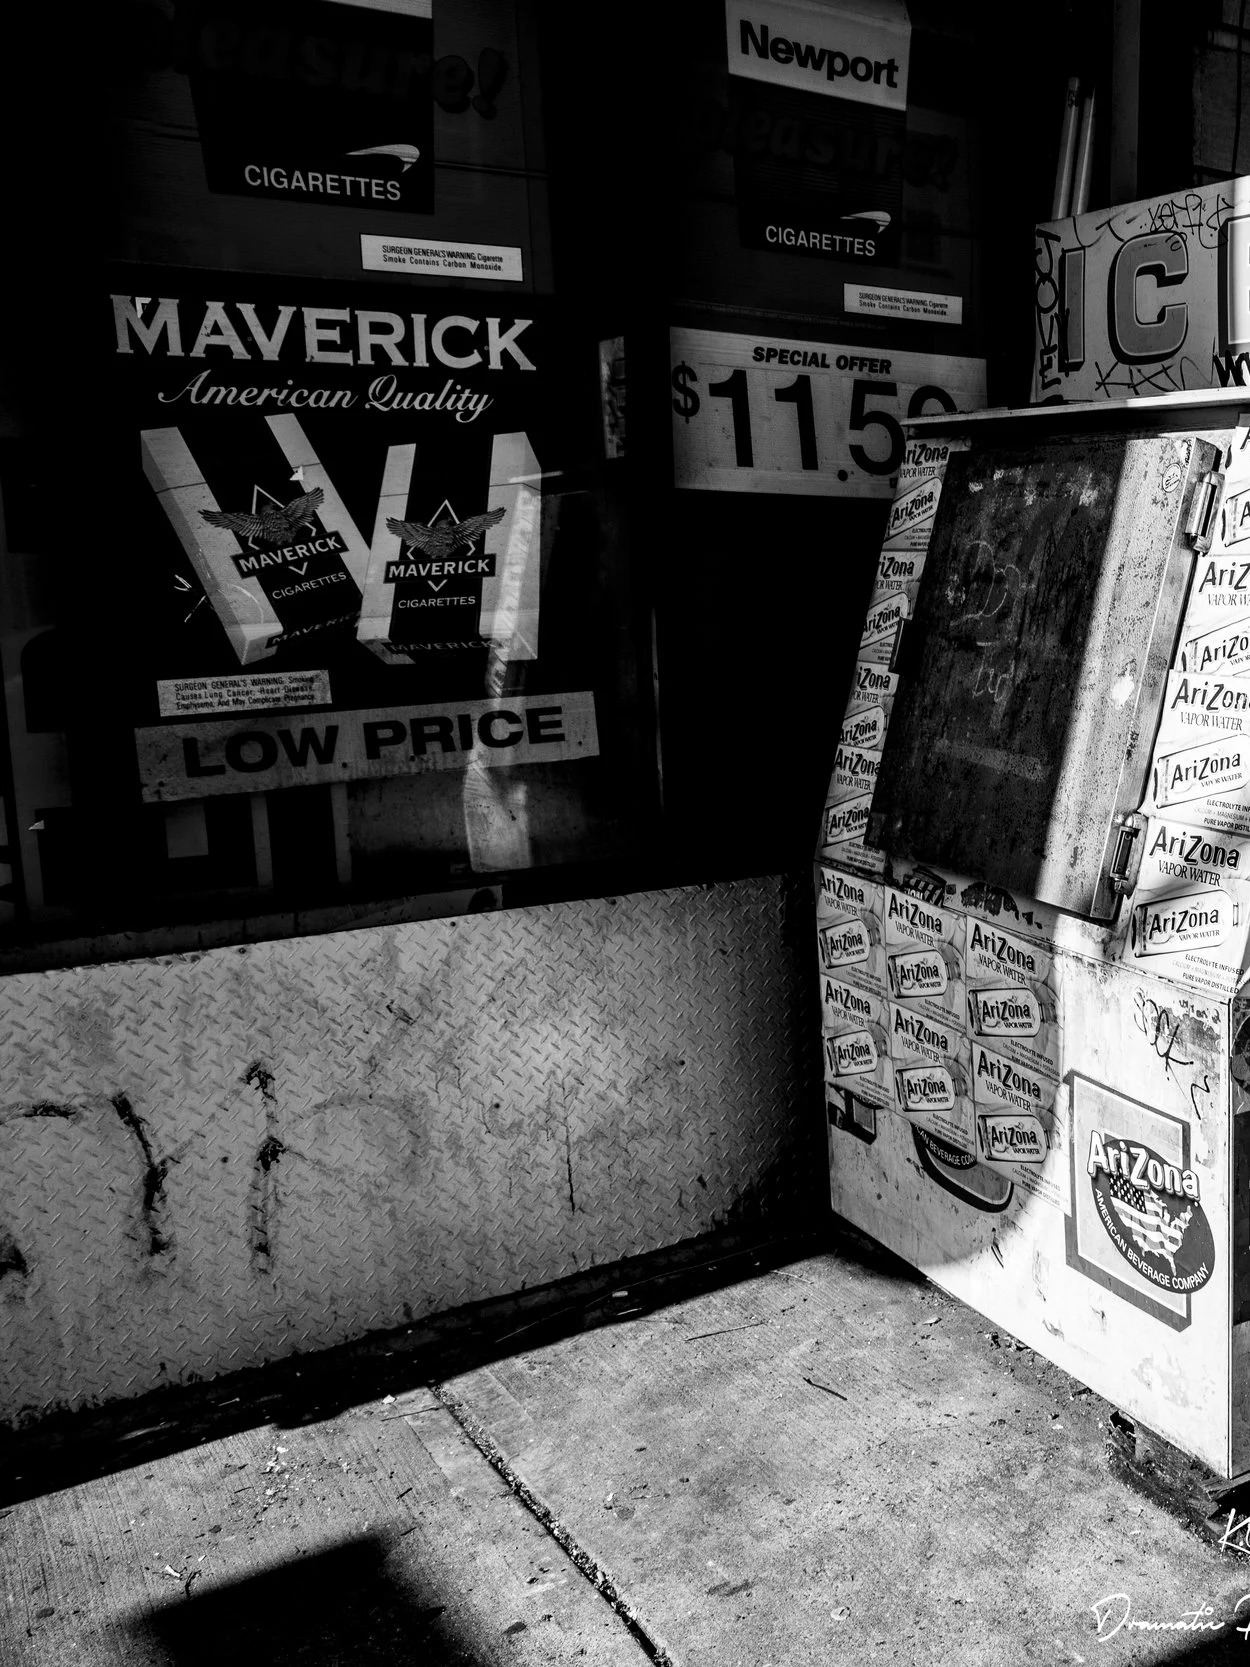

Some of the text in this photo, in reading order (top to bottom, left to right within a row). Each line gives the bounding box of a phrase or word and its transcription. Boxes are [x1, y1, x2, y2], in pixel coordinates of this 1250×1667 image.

[739, 20, 899, 89] Newport
[244, 165, 401, 202] CIGARETTES
[382, 245, 413, 255] SURGEON
[413, 249, 446, 258] GENERAL'S
[477, 253, 503, 263] Cigarette
[765, 225, 876, 257] CIGARETTES
[383, 255, 406, 264] Smoke
[410, 257, 440, 267] Contains
[443, 259, 466, 269] Carbon
[109, 293, 537, 371] MAVERICK
[752, 346, 892, 374] SPECIAL OFFER
[157, 369, 494, 423] American Quality
[891, 491, 934, 528] AriZona
[238, 536, 343, 573] MAVERICK
[389, 559, 490, 579] MAVERICK
[271, 572, 347, 600] CIGARETTES
[1208, 594, 1237, 606] VAPOR
[398, 596, 476, 609] CIGARETTES
[175, 682, 207, 692] SURGEON
[211, 680, 247, 690] GENERAL'S
[176, 690, 202, 701] Causes
[204, 689, 223, 700] Lung
[260, 686, 281, 695] Heart
[1180, 711, 1243, 731] VAPOR WATER
[182, 706, 565, 779] LOW PRICE
[834, 749, 881, 776] AriZona
[1170, 752, 1241, 789] AriZona
[1206, 799, 1241, 812] ELECTROLYTE
[829, 807, 869, 835] AriZona
[1203, 817, 1217, 826] PURE
[1217, 820, 1234, 830] VAPOR
[1149, 826, 1240, 869] AriZona
[820, 870, 864, 904] AriZona
[1159, 860, 1221, 888] VAPOR WATER
[888, 893, 943, 936] AriZona
[1149, 908, 1219, 939] AriZona
[829, 930, 863, 956] AriZona
[970, 923, 1036, 974] AriZona
[900, 962, 940, 983] AriZona
[978, 953, 1028, 986] VAPOR WATER
[1185, 953, 1245, 976] ELECTROLYTE INFUSED
[825, 980, 871, 1017] AriZona
[982, 994, 1031, 1021] AriZona
[894, 1008, 949, 1053] AriZona
[837, 1043, 871, 1066] AriZona
[906, 1077, 947, 1098] AriZona
[977, 1051, 1041, 1102] AriZona
[985, 1080, 1032, 1112] VAPOR WATER
[990, 1123, 1037, 1147] AriZona
[1087, 1130, 1200, 1200] AriZona
[1095, 1188, 1210, 1289] AMERICAN BEVERAGE COMPANY
